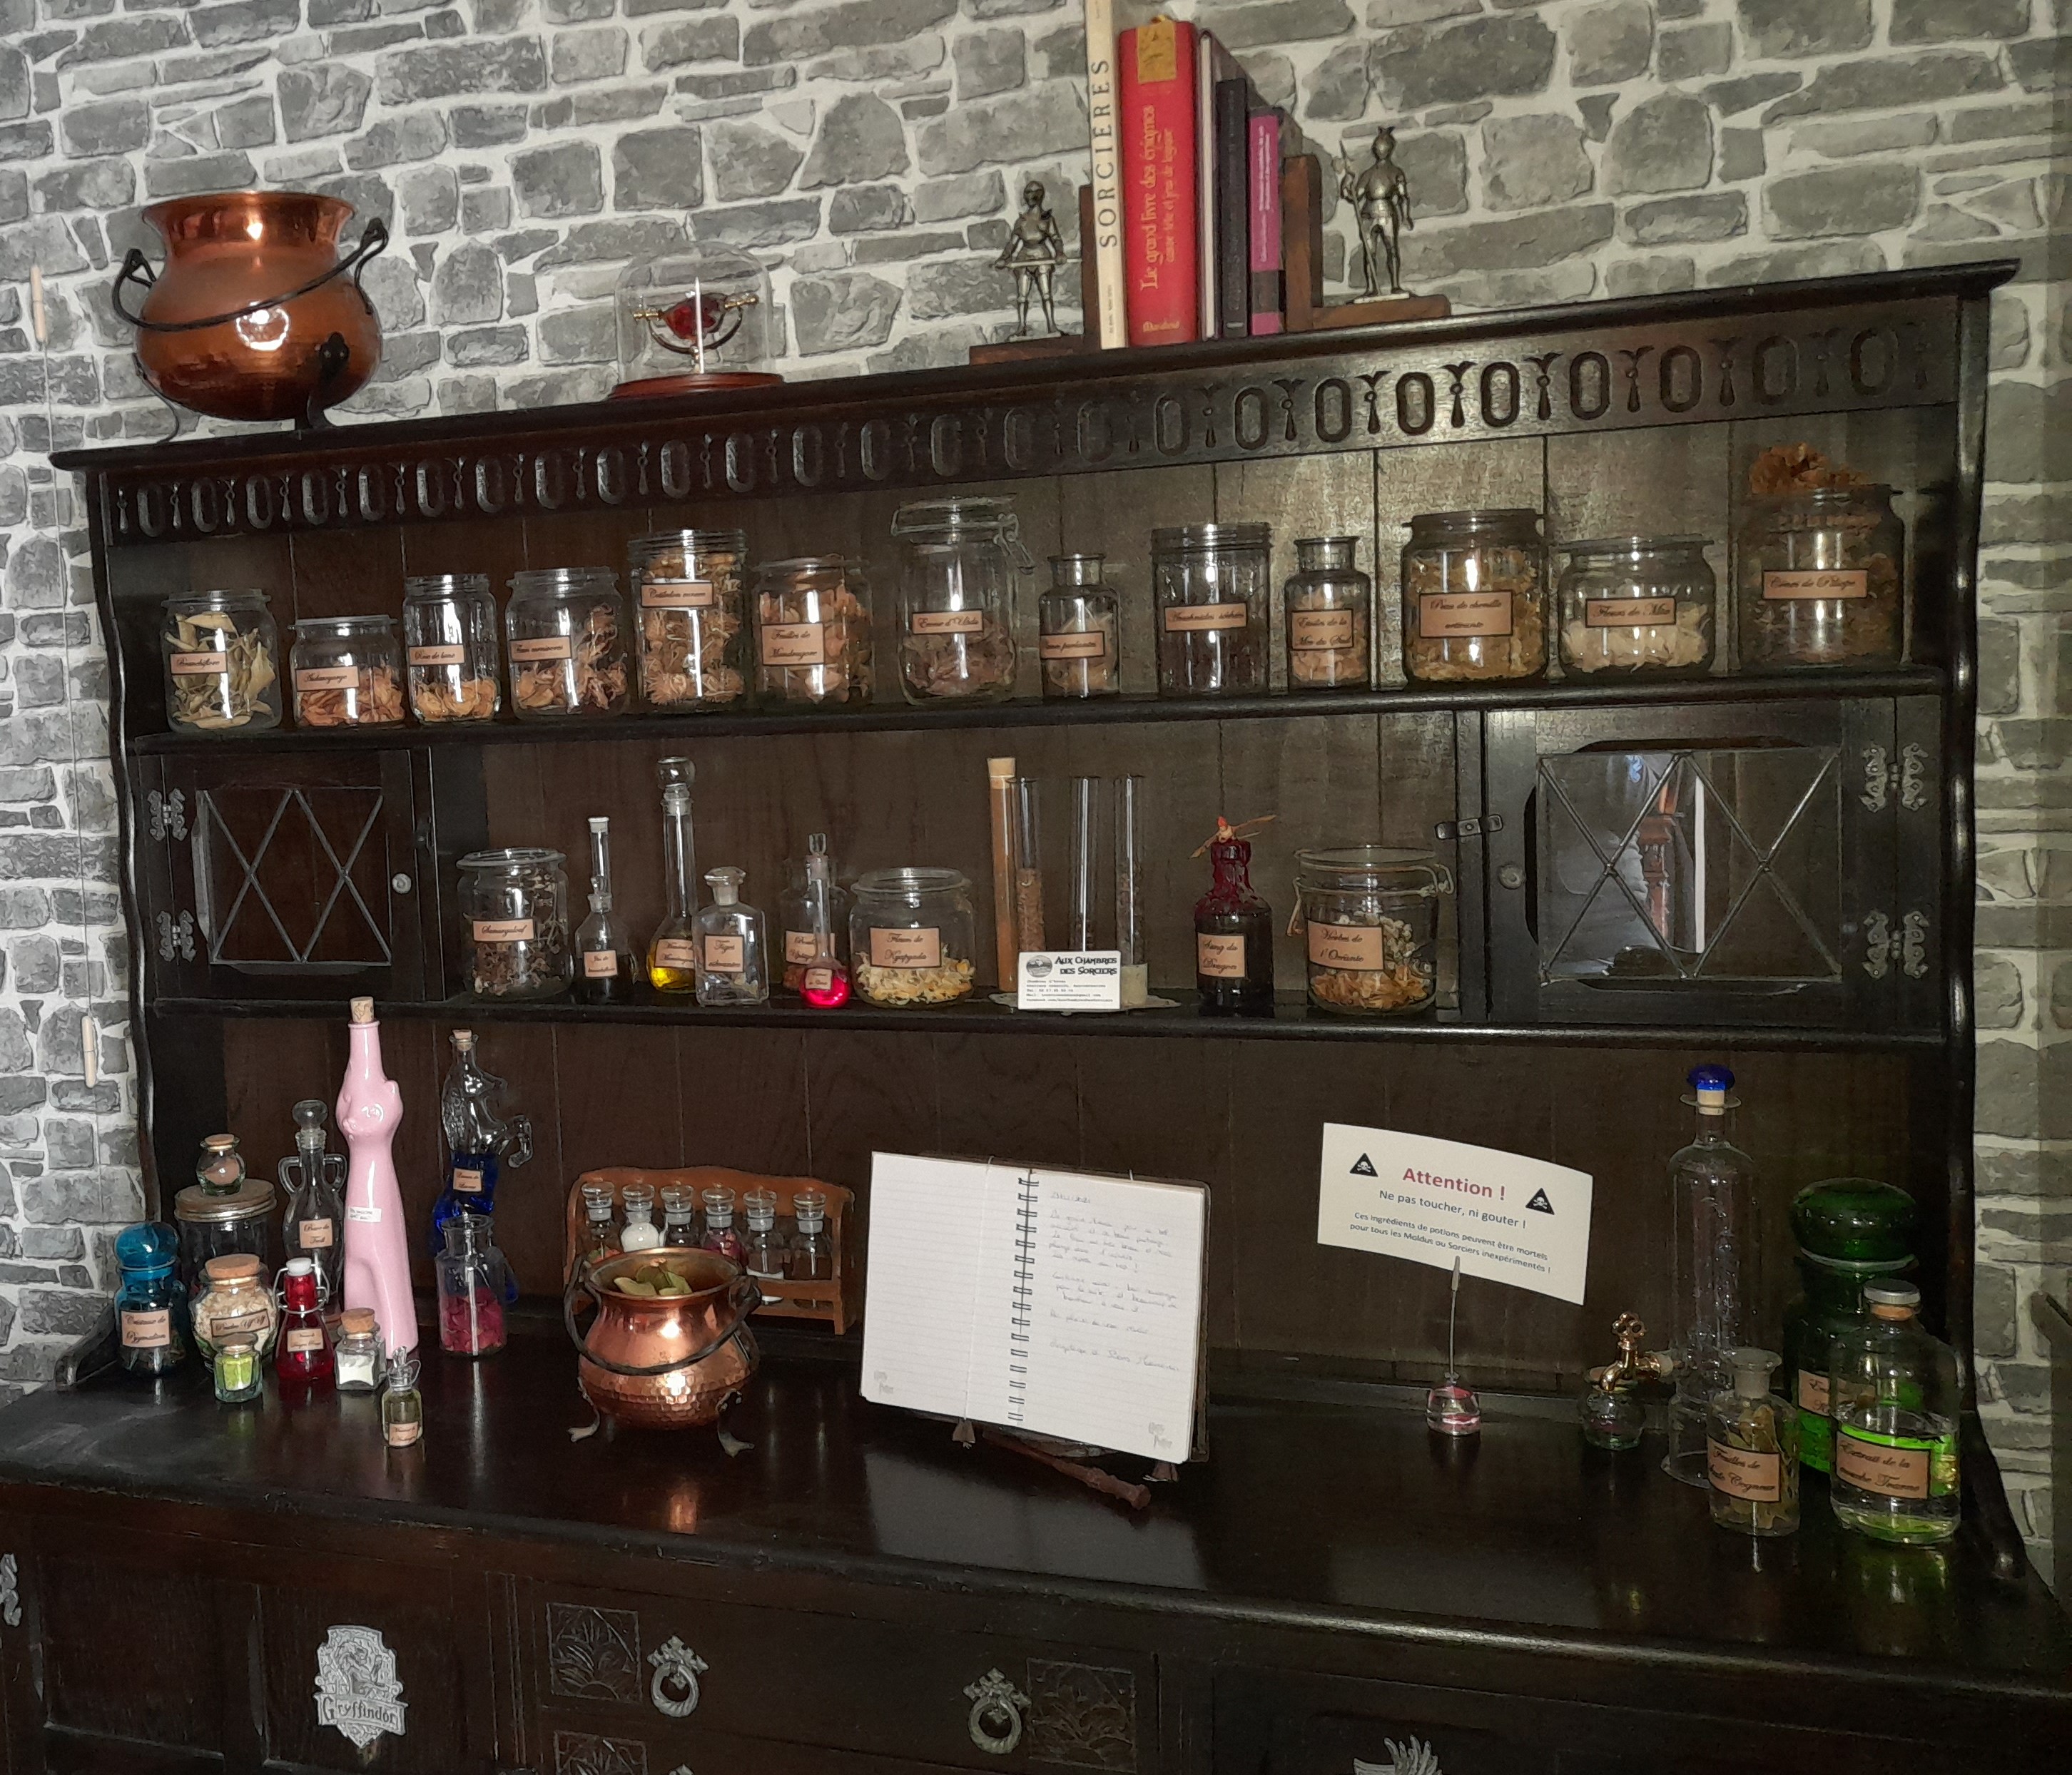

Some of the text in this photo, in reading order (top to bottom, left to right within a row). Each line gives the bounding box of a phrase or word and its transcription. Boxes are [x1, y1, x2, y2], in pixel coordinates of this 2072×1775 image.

[1402, 1167, 1505, 1201] Attention !
[1378, 1189, 1526, 1229] Ne pas toucher, ni gouter !
[1349, 1224, 1369, 1232] pour
[1370, 1226, 1388, 1236] tous
[1390, 1229, 1402, 1238] les
[1403, 1232, 1433, 1245] Moldus
[1435, 1240, 1446, 1248] ou
[1448, 1241, 1481, 1256] Sorciers
[1354, 1211, 1369, 1221] Ces
[1417, 1223, 1428, 1232] de
[1429, 1226, 1460, 1239] potions
[1461, 1234, 1495, 1247] peuvent
[1497, 1241, 1515, 1252] être
[1516, 1246, 1548, 1261] mortels
[323, 1696, 396, 1724] Gryffindor
